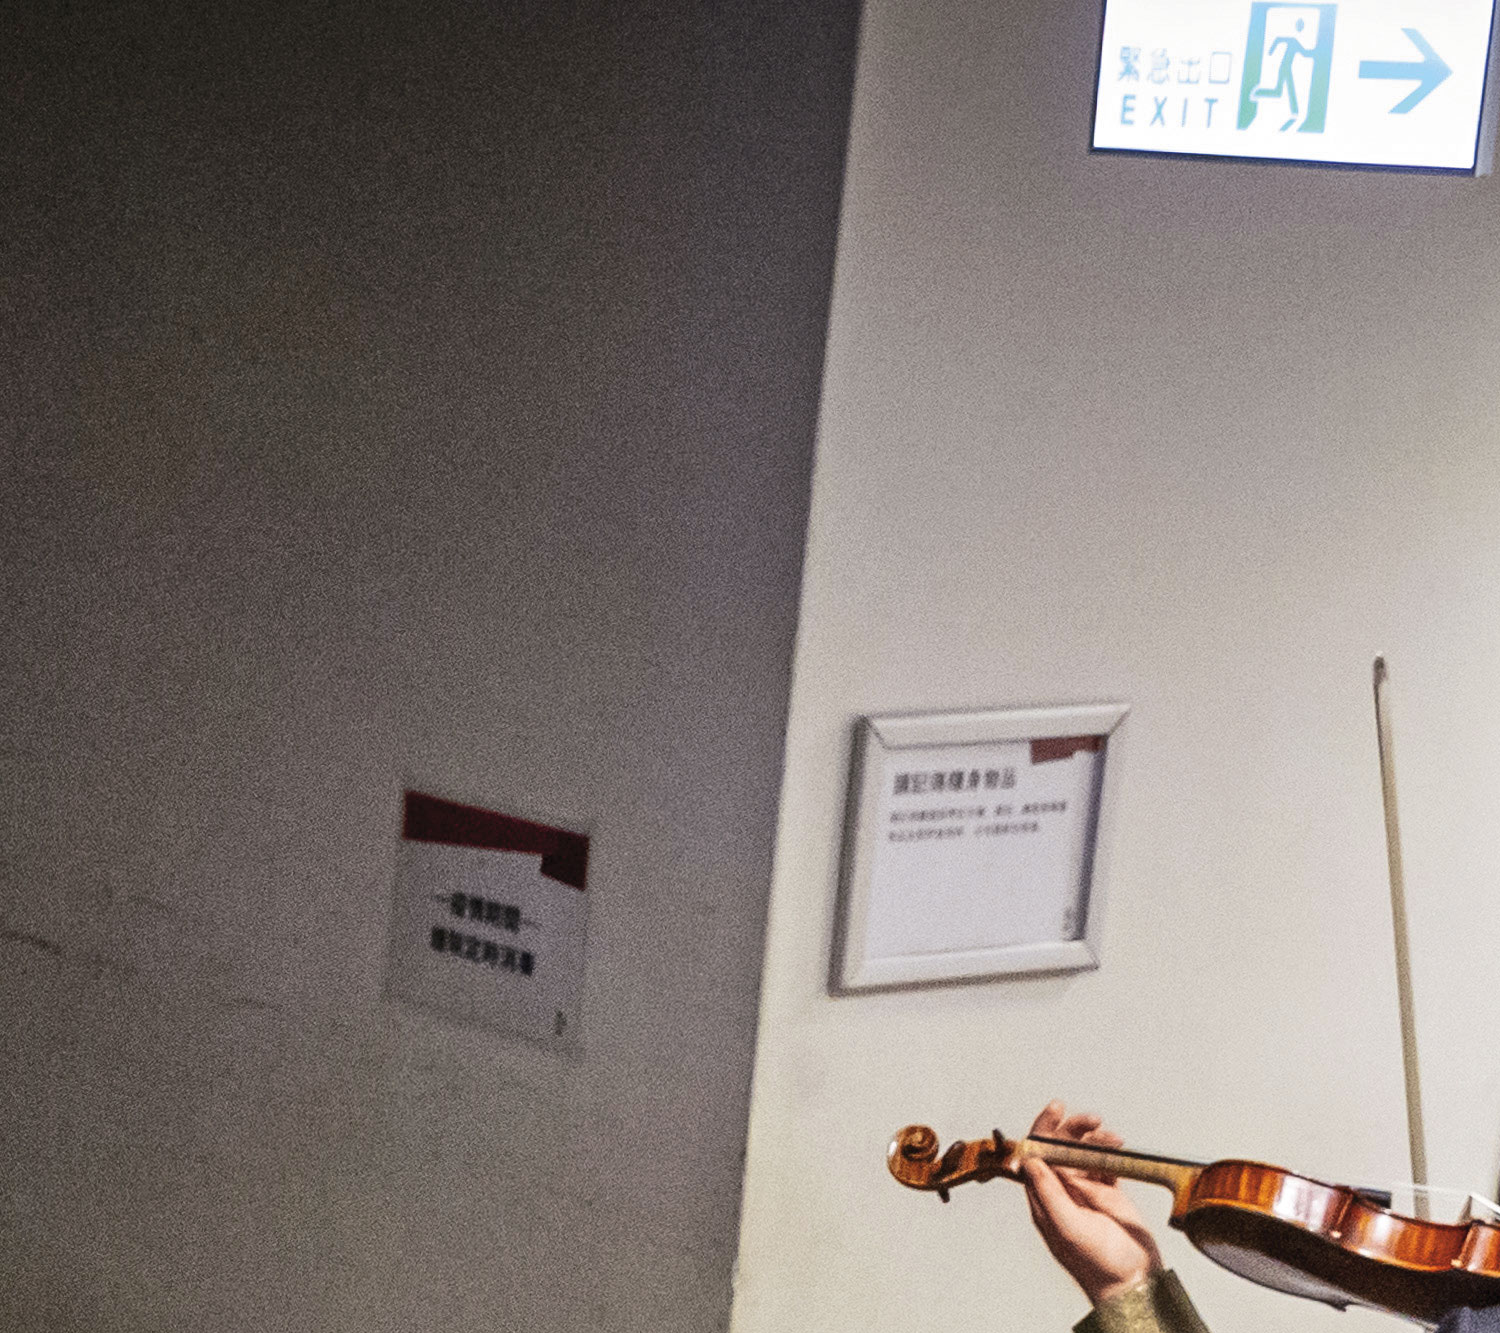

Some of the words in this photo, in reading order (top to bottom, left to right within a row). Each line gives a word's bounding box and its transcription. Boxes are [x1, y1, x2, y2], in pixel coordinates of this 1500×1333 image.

[1117, 45, 1232, 85] 緊急出口
[1119, 94, 1219, 128] EXIT
